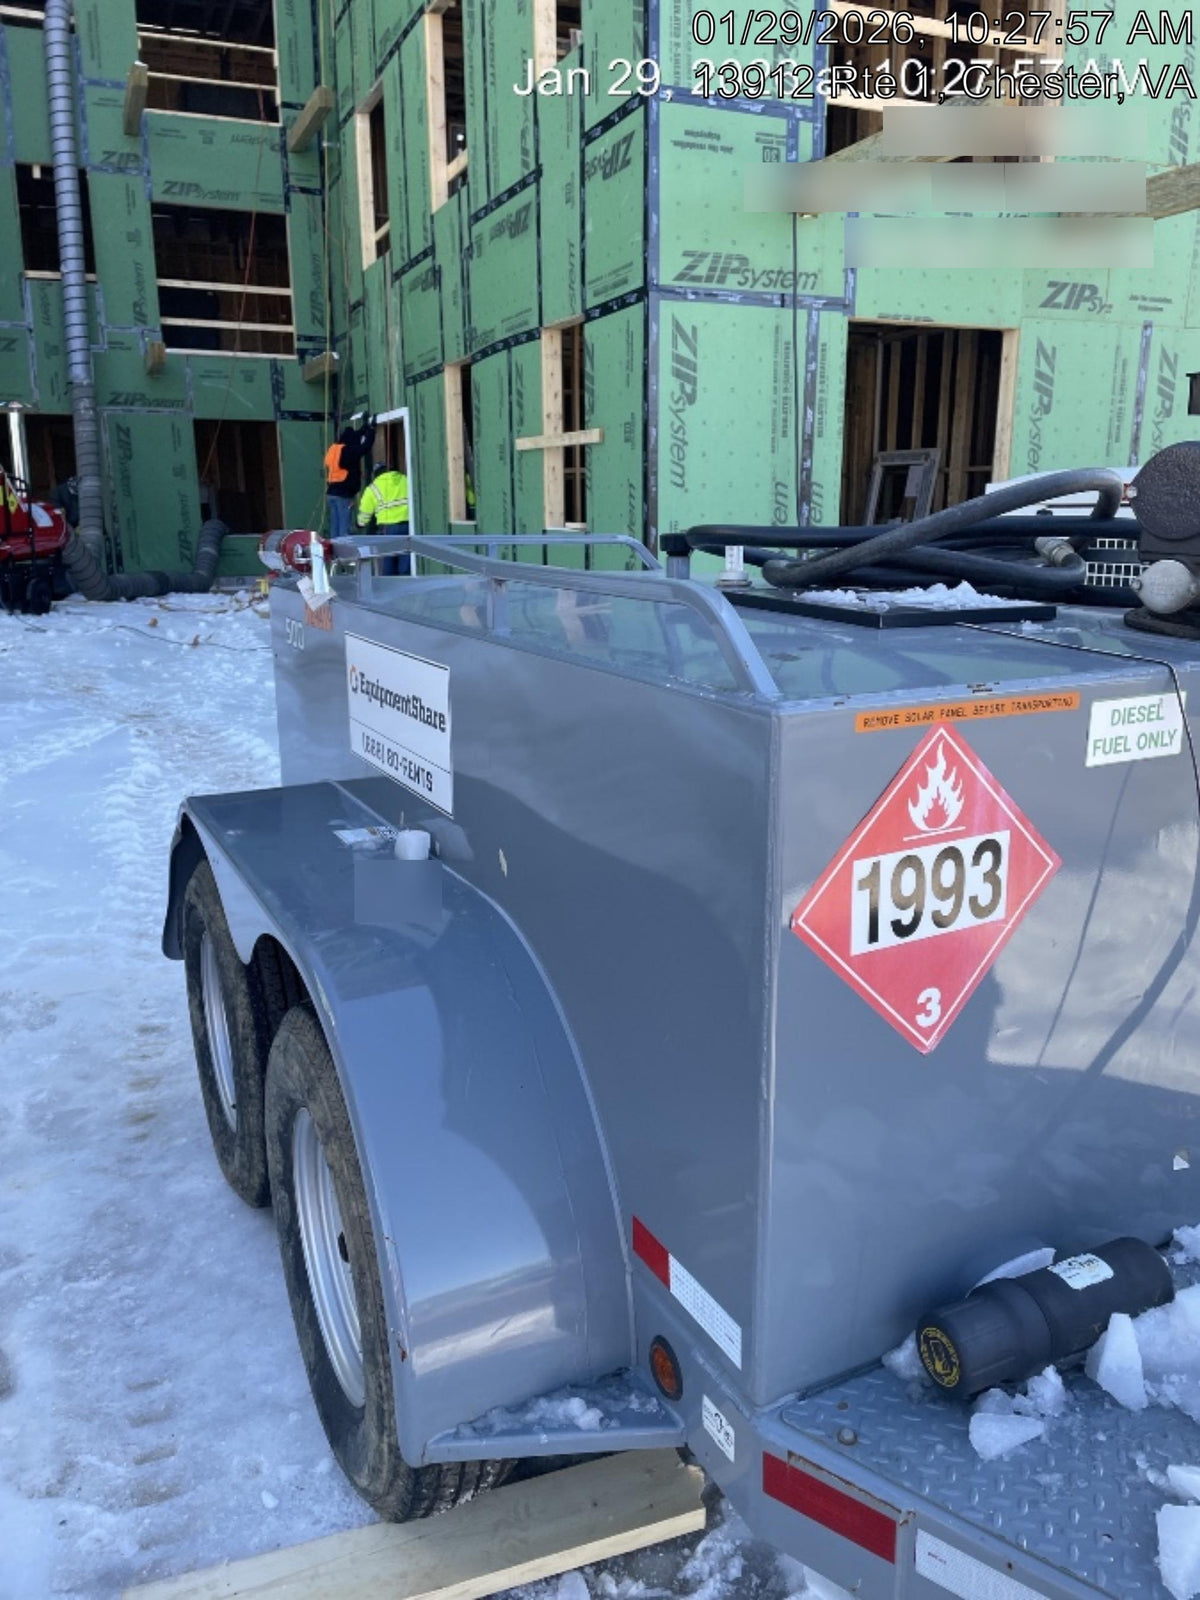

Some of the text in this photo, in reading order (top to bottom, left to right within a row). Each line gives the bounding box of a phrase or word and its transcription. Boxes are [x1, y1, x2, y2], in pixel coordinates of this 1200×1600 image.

[359, 671, 447, 733] EquipmentShare
[863, 714, 899, 729] REMOVE
[905, 710, 934, 723] SOLAR
[940, 707, 967, 719] PANEL
[1111, 703, 1164, 726] DIESEL
[1093, 728, 1178, 757] FUEL ONLY
[857, 838, 1003, 944] 1993
[916, 988, 941, 1028] 3
